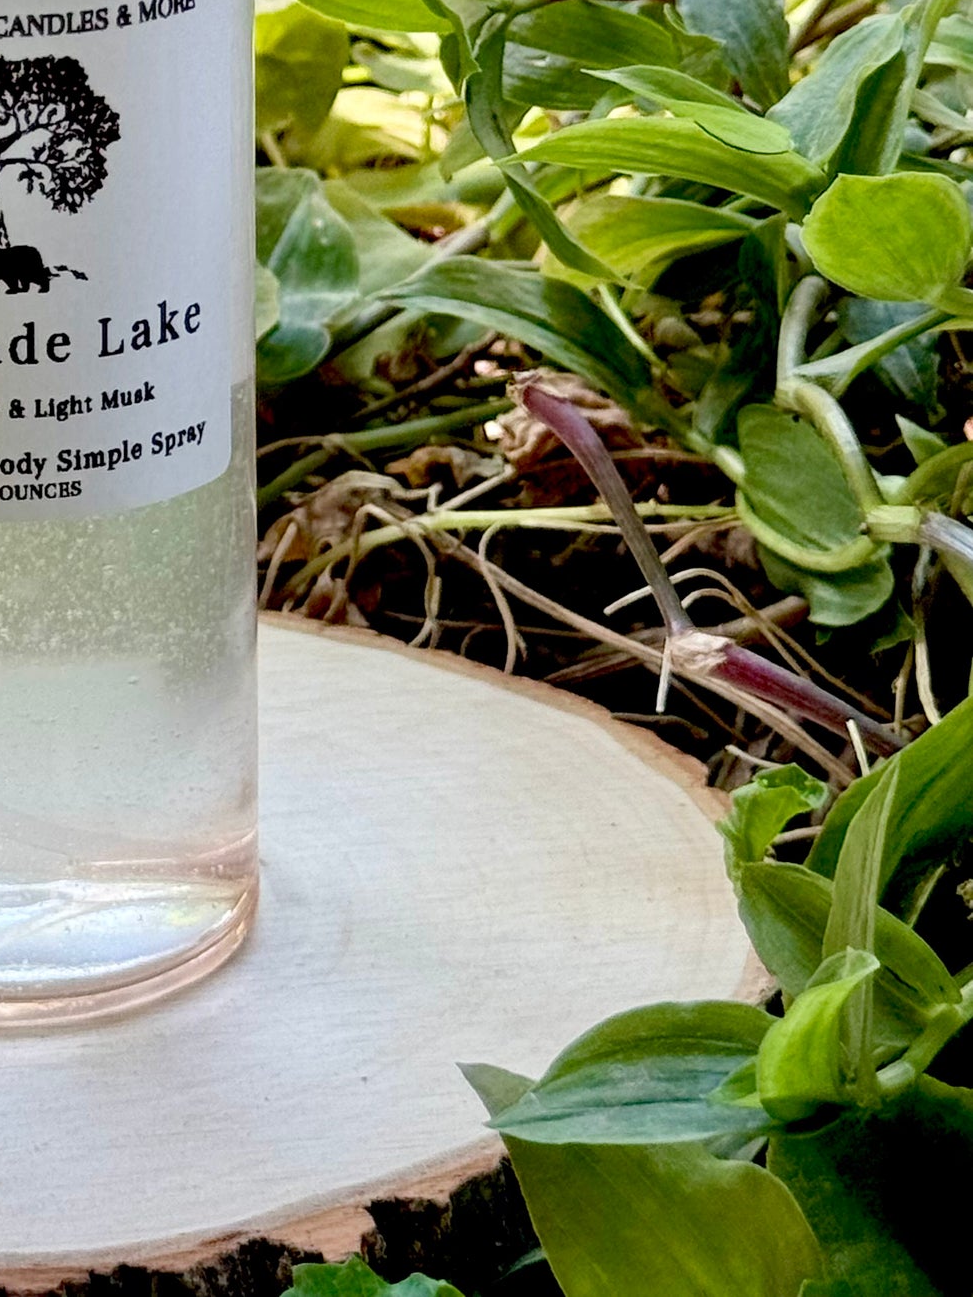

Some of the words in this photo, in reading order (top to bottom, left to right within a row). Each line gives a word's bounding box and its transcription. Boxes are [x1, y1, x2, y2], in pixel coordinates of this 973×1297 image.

[116, 4, 131, 27] &
[98, 300, 200, 358] Lake
[9, 399, 25, 419] &
[34, 393, 93, 422] Light
[100, 381, 156, 410] Musk
[56, 440, 142, 473] Simple
[151, 420, 206, 456] Spray
